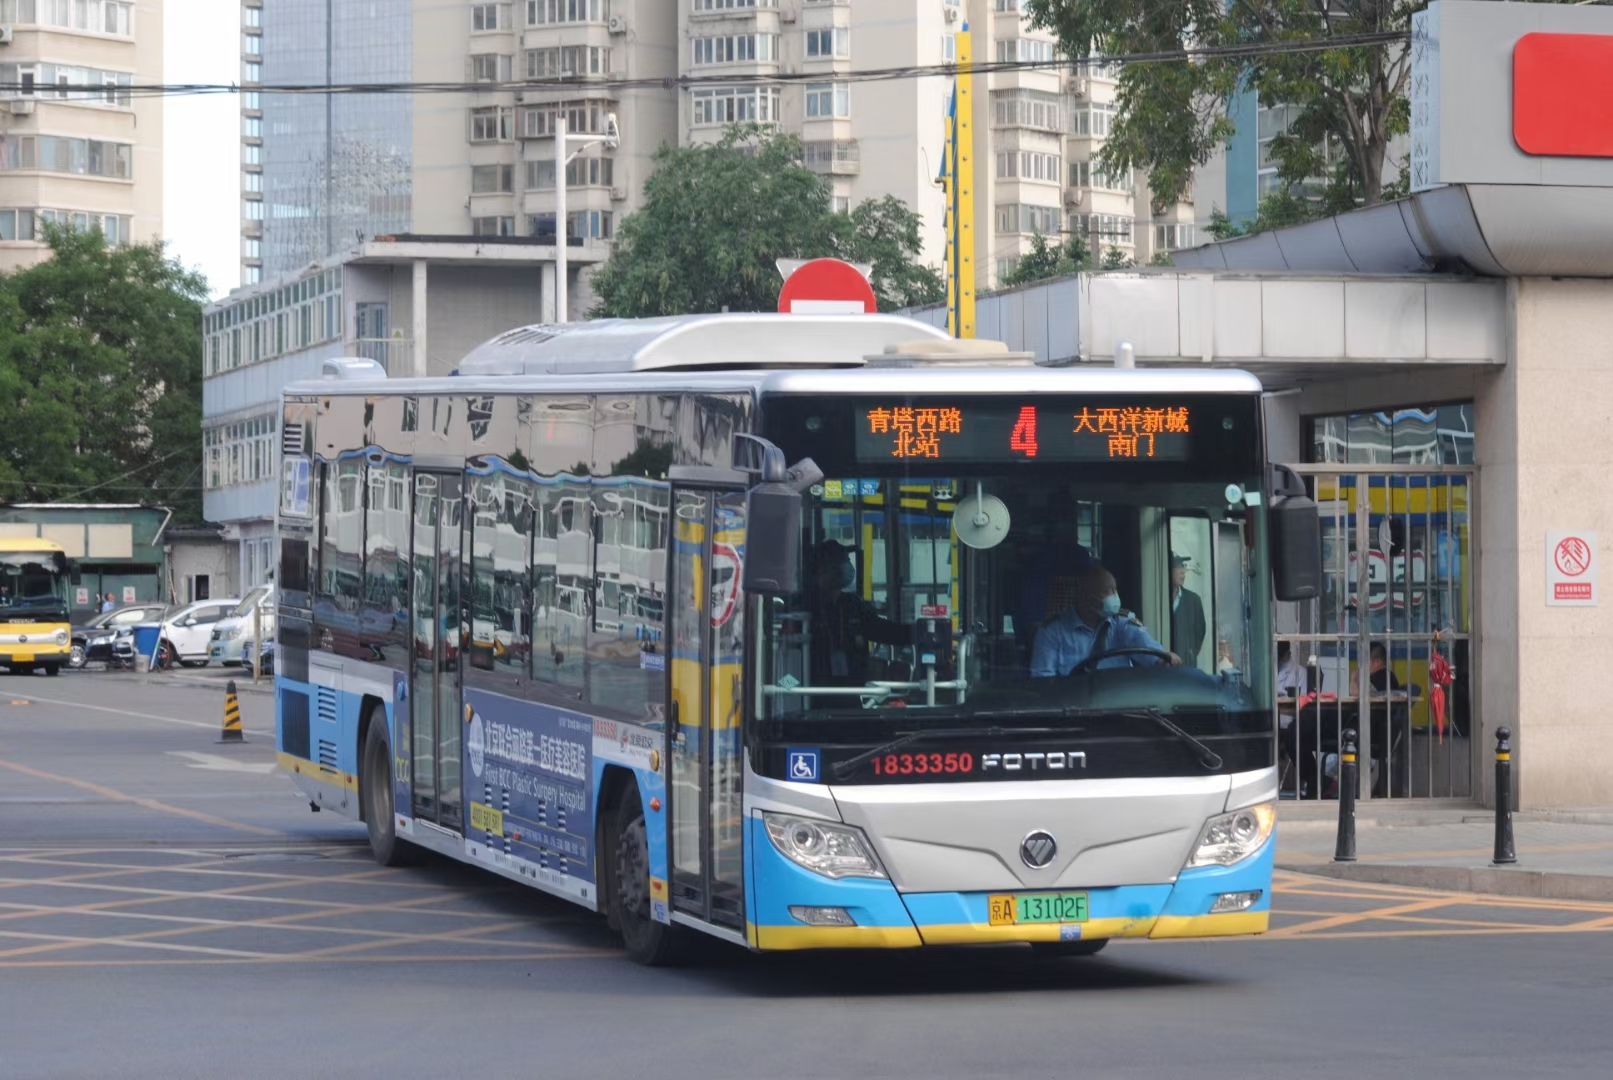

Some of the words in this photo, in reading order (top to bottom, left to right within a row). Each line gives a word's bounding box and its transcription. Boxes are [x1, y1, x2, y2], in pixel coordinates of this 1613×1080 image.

[867, 407, 962, 434] 青塔西路
[1010, 406, 1037, 456] 4
[1073, 406, 1189, 433] 大西洋新城
[892, 431, 940, 458] 北站
[1108, 432, 1154, 458] 南门
[871, 753, 973, 775] 1833350
[981, 751, 1087, 770] FOTON
[485, 764, 499, 786] First
[512, 770, 532, 795] Plastic
[533, 777, 558, 806] Surgery
[559, 784, 586, 813] Hospital
